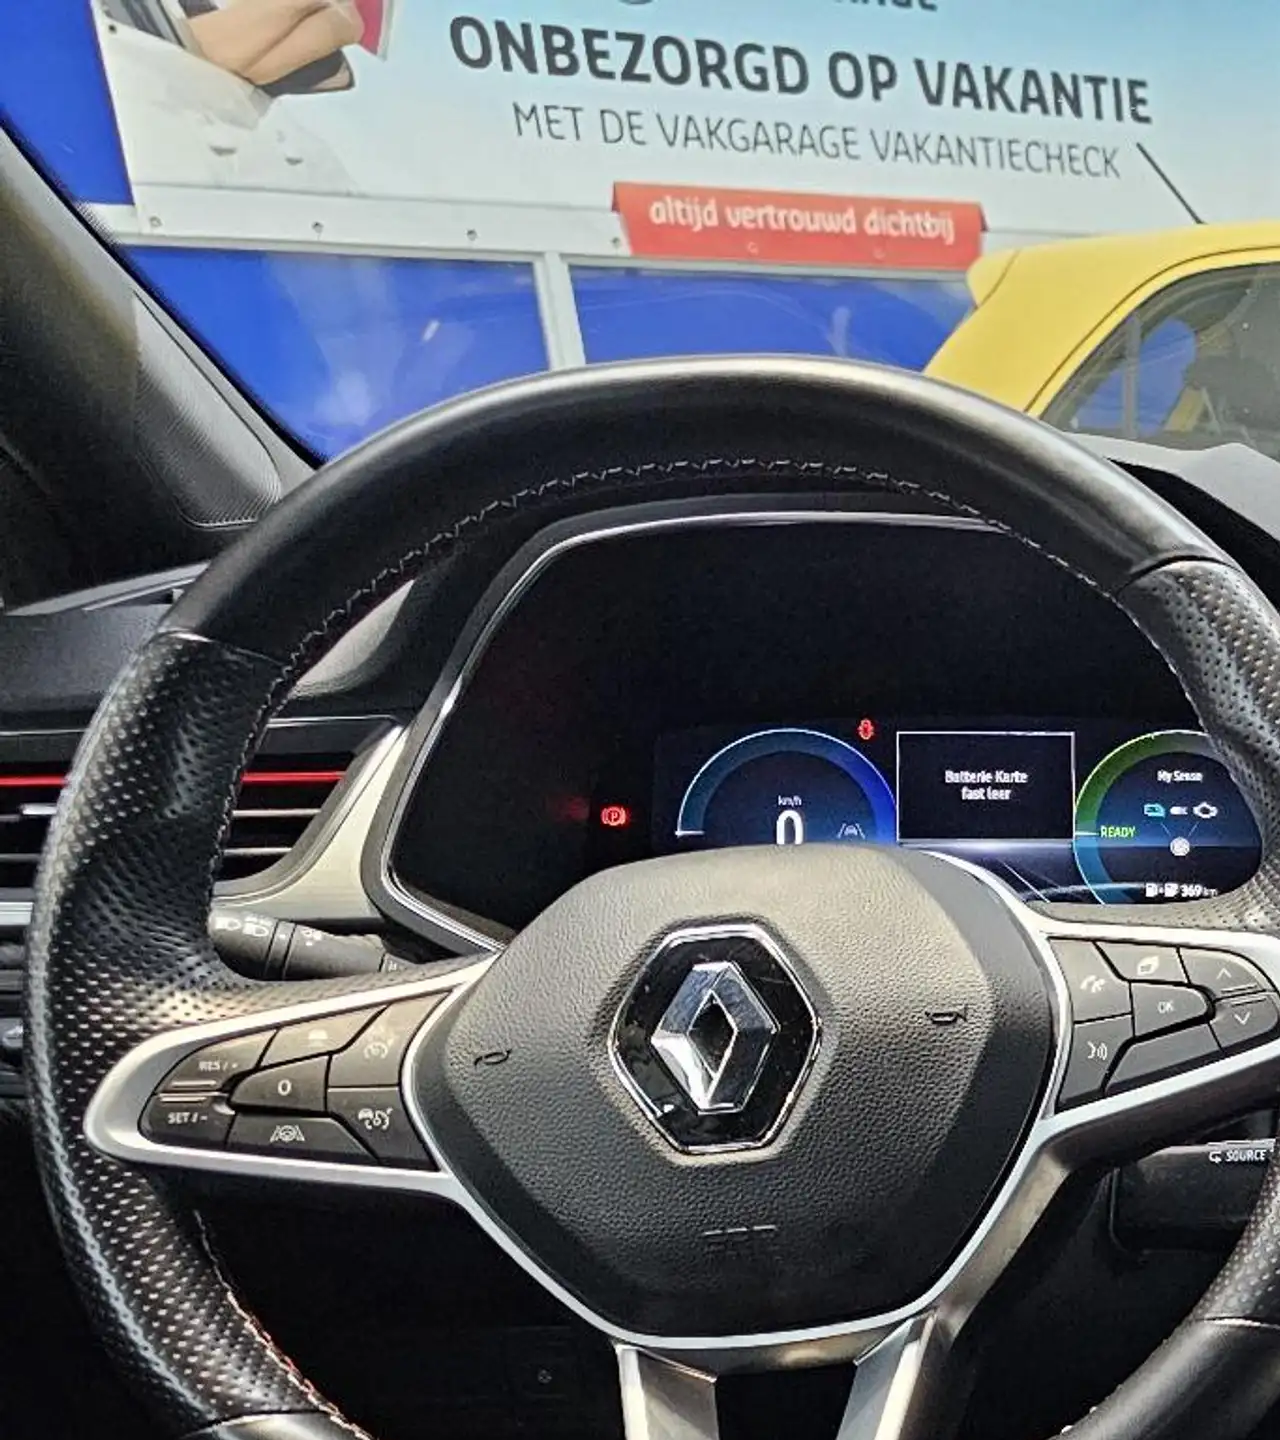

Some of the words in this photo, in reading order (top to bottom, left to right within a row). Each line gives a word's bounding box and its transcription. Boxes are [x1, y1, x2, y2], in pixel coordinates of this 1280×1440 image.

[449, 15, 809, 95] ONBEZORGD
[828, 51, 898, 101] OP
[913, 58, 1153, 124] VAKANTIE
[512, 101, 584, 142] MET
[600, 109, 647, 146] DE
[656, 112, 860, 161] VAKGARAGE
[869, 128, 1122, 179] VAKANTIECHECK
[649, 196, 719, 232] altijd
[725, 202, 856, 234] vertrouwd
[863, 208, 955, 245] dichtbij
[945, 770, 993, 783] Batterie
[996, 770, 1028, 783] Karte
[961, 786, 984, 801] fast
[987, 787, 1011, 800] leer
[778, 795, 802, 807] km/h
[1100, 825, 1136, 838] READY
[1181, 884, 1202, 898] 369
[1158, 1000, 1174, 1014] OK
[1225, 1149, 1267, 1162] SOURCE
